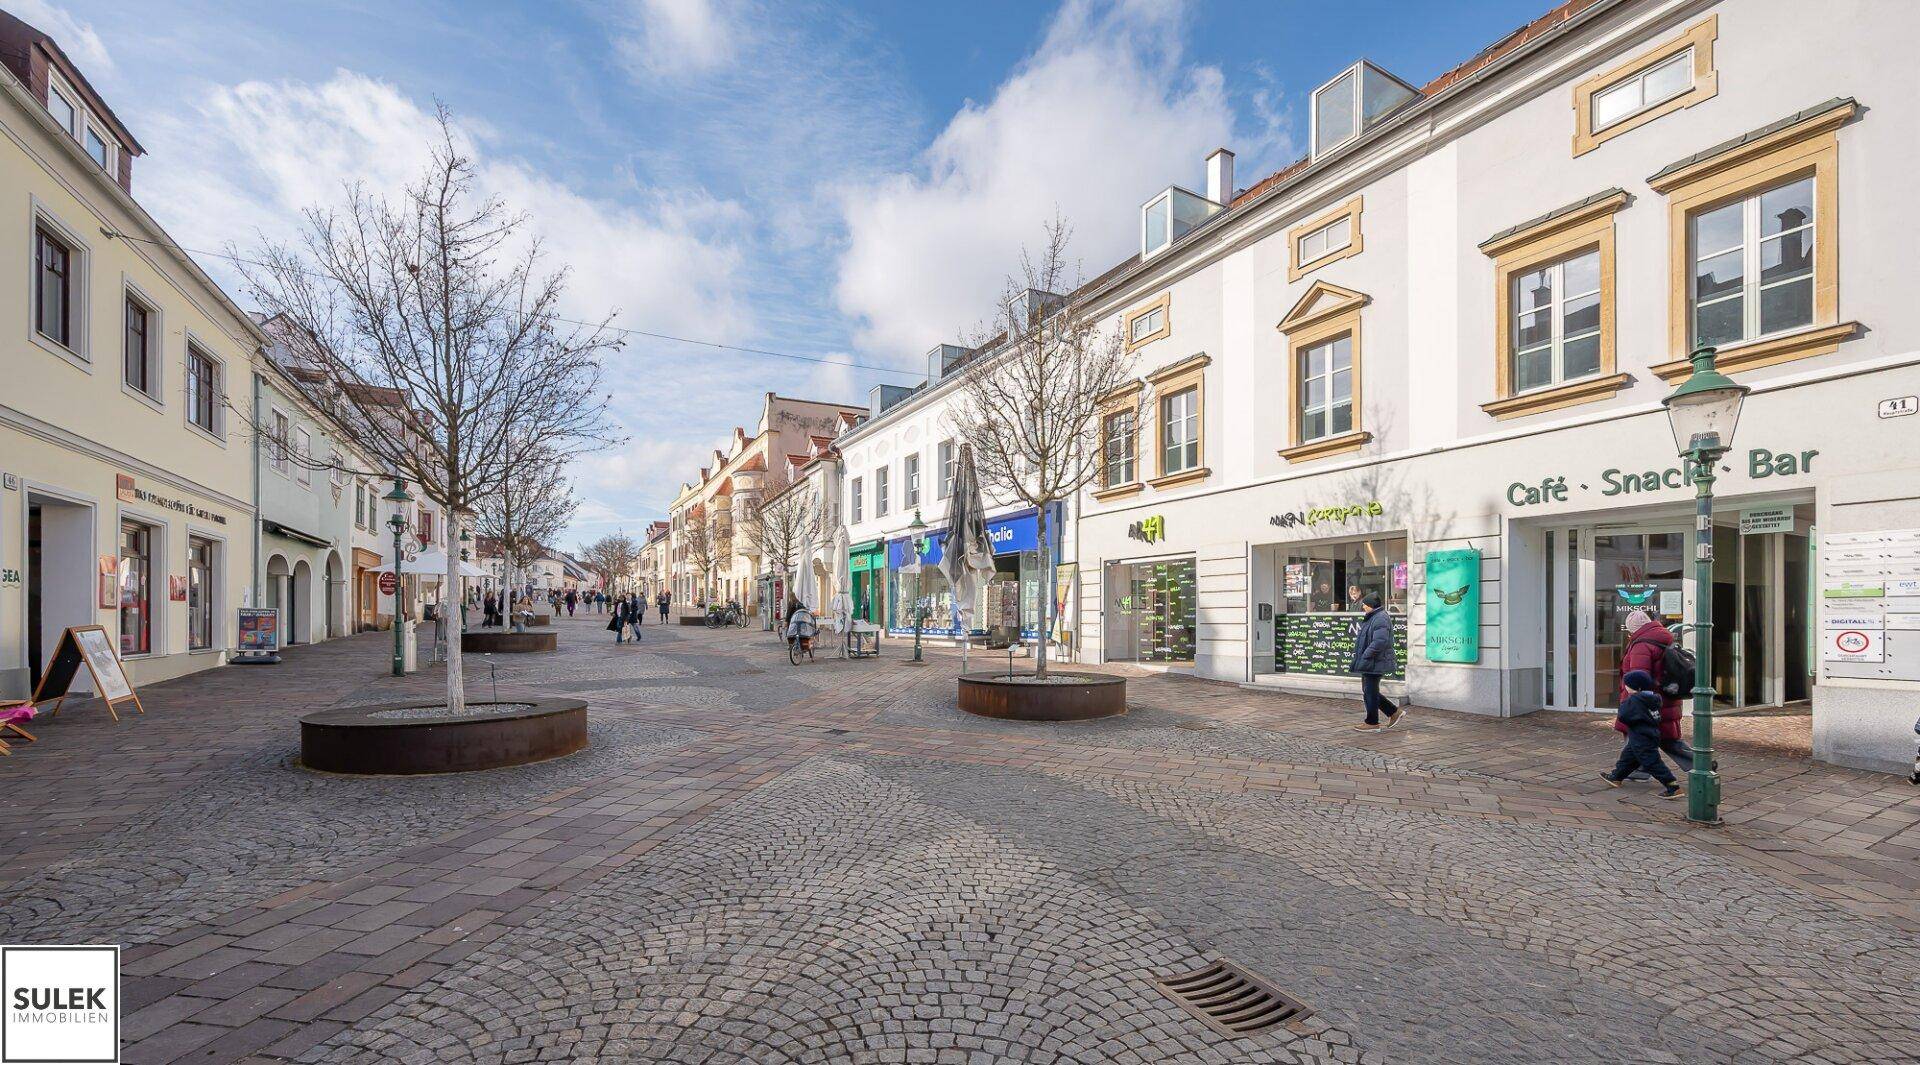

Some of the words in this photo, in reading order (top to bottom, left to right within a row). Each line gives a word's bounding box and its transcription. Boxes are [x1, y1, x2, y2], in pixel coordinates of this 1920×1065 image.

[1889, 400, 1906, 410] 41
[1506, 476, 1568, 507] Café
[1748, 448, 1820, 479] Bar
[1430, 635, 1473, 645] MIKSCHI
